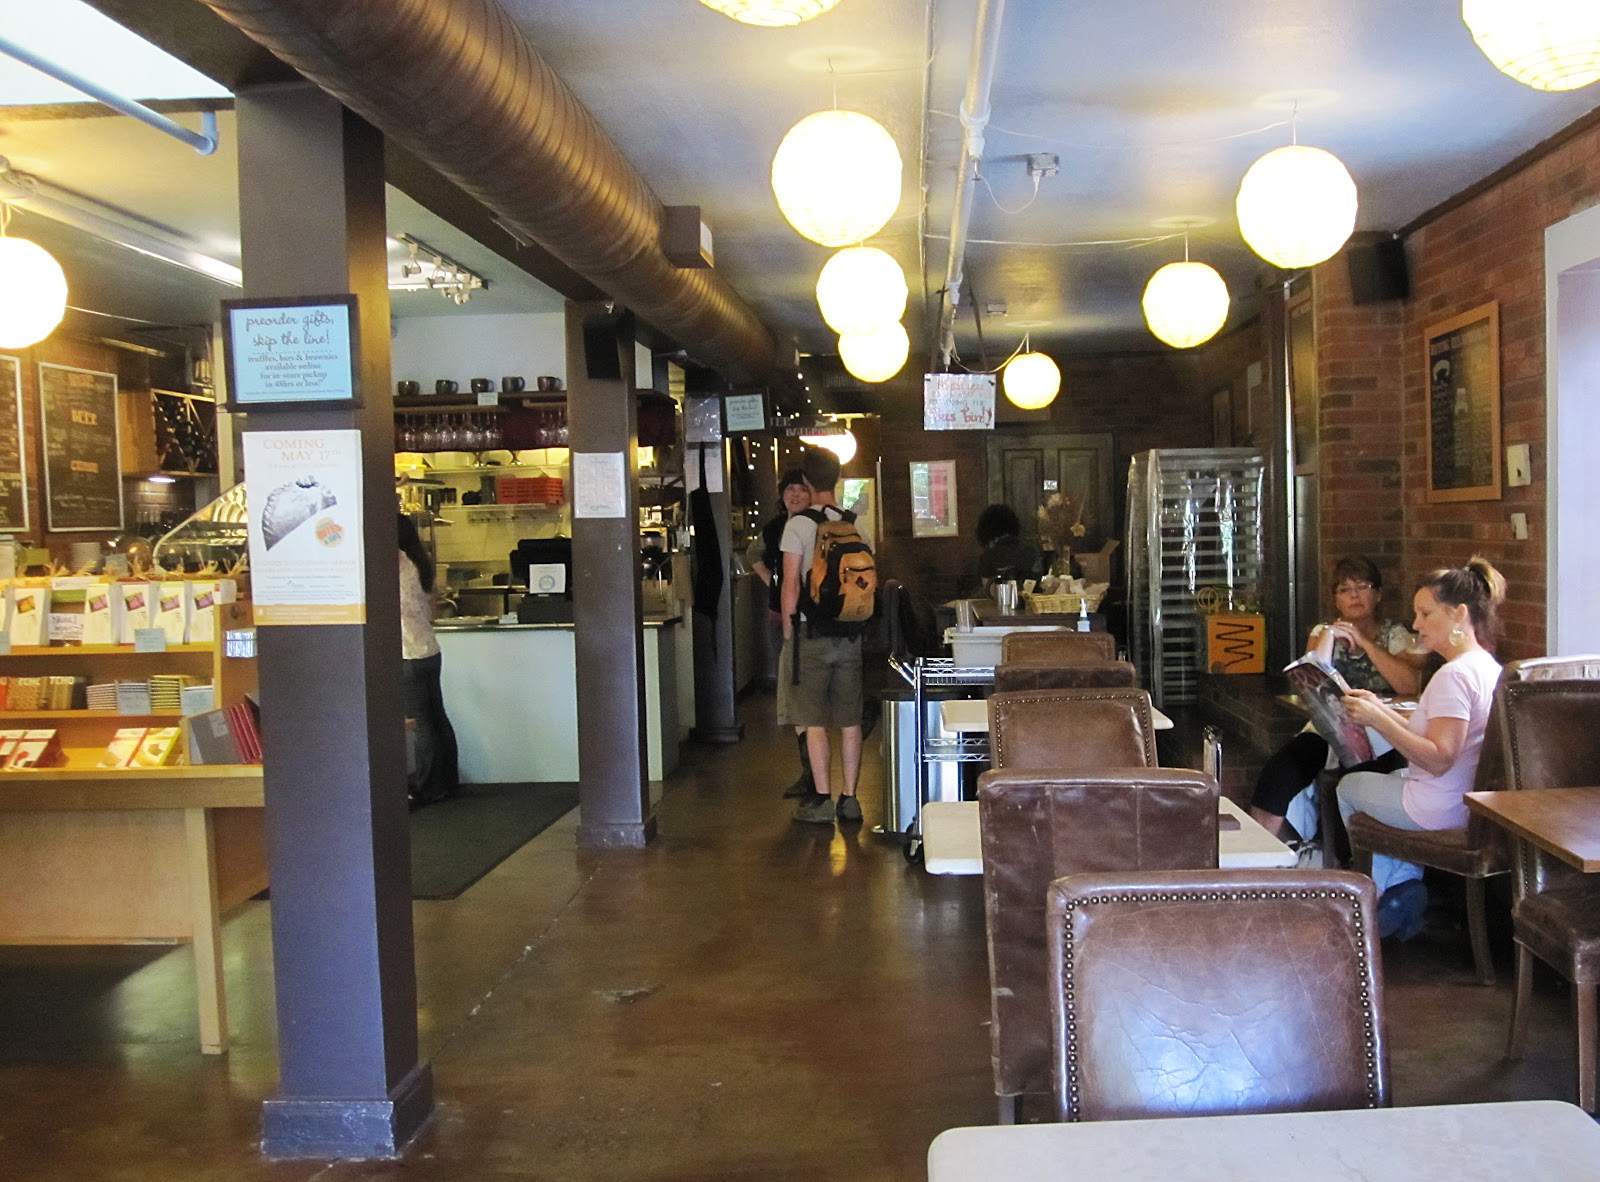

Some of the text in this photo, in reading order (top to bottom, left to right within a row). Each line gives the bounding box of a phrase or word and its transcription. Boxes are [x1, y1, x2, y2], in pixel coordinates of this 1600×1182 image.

[246, 310, 334, 332] preorder gifts,
[253, 329, 330, 351] skip the line!
[305, 353, 338, 361] brownies
[265, 361, 321, 370] available online
[302, 371, 328, 381] pickup
[263, 438, 325, 450] COMING
[281, 450, 312, 461] MAY
